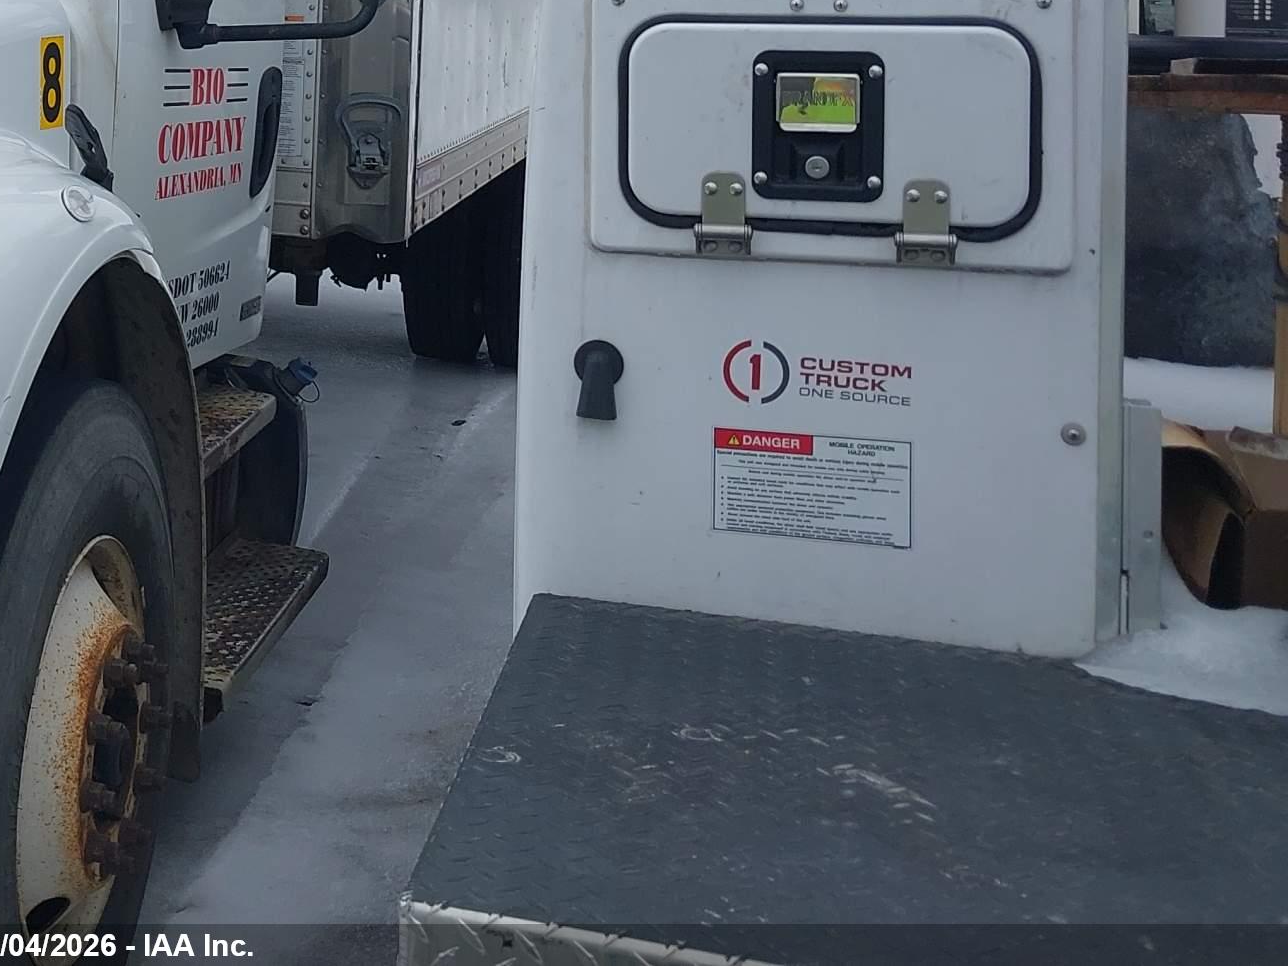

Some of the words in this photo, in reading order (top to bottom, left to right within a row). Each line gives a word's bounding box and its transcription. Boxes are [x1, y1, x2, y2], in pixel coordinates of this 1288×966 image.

[43, 42, 61, 123] 8
[191, 67, 224, 106] BIO
[158, 116, 246, 164] COMPANY
[155, 166, 226, 201] ALEXANDRIA,
[230, 162, 243, 185] MN
[198, 260, 231, 291] 506624
[192, 292, 219, 320] 26000
[800, 357, 912, 379] CUSTOM
[800, 372, 886, 392] TRUCK
[799, 387, 835, 399] ONE
[839, 391, 911, 407] SOURCE
[742, 435, 800, 449] DANGER
[829, 441, 854, 449] MOBILE
[857, 443, 895, 452] OPERATION
[847, 449, 876, 457] HAZARD
